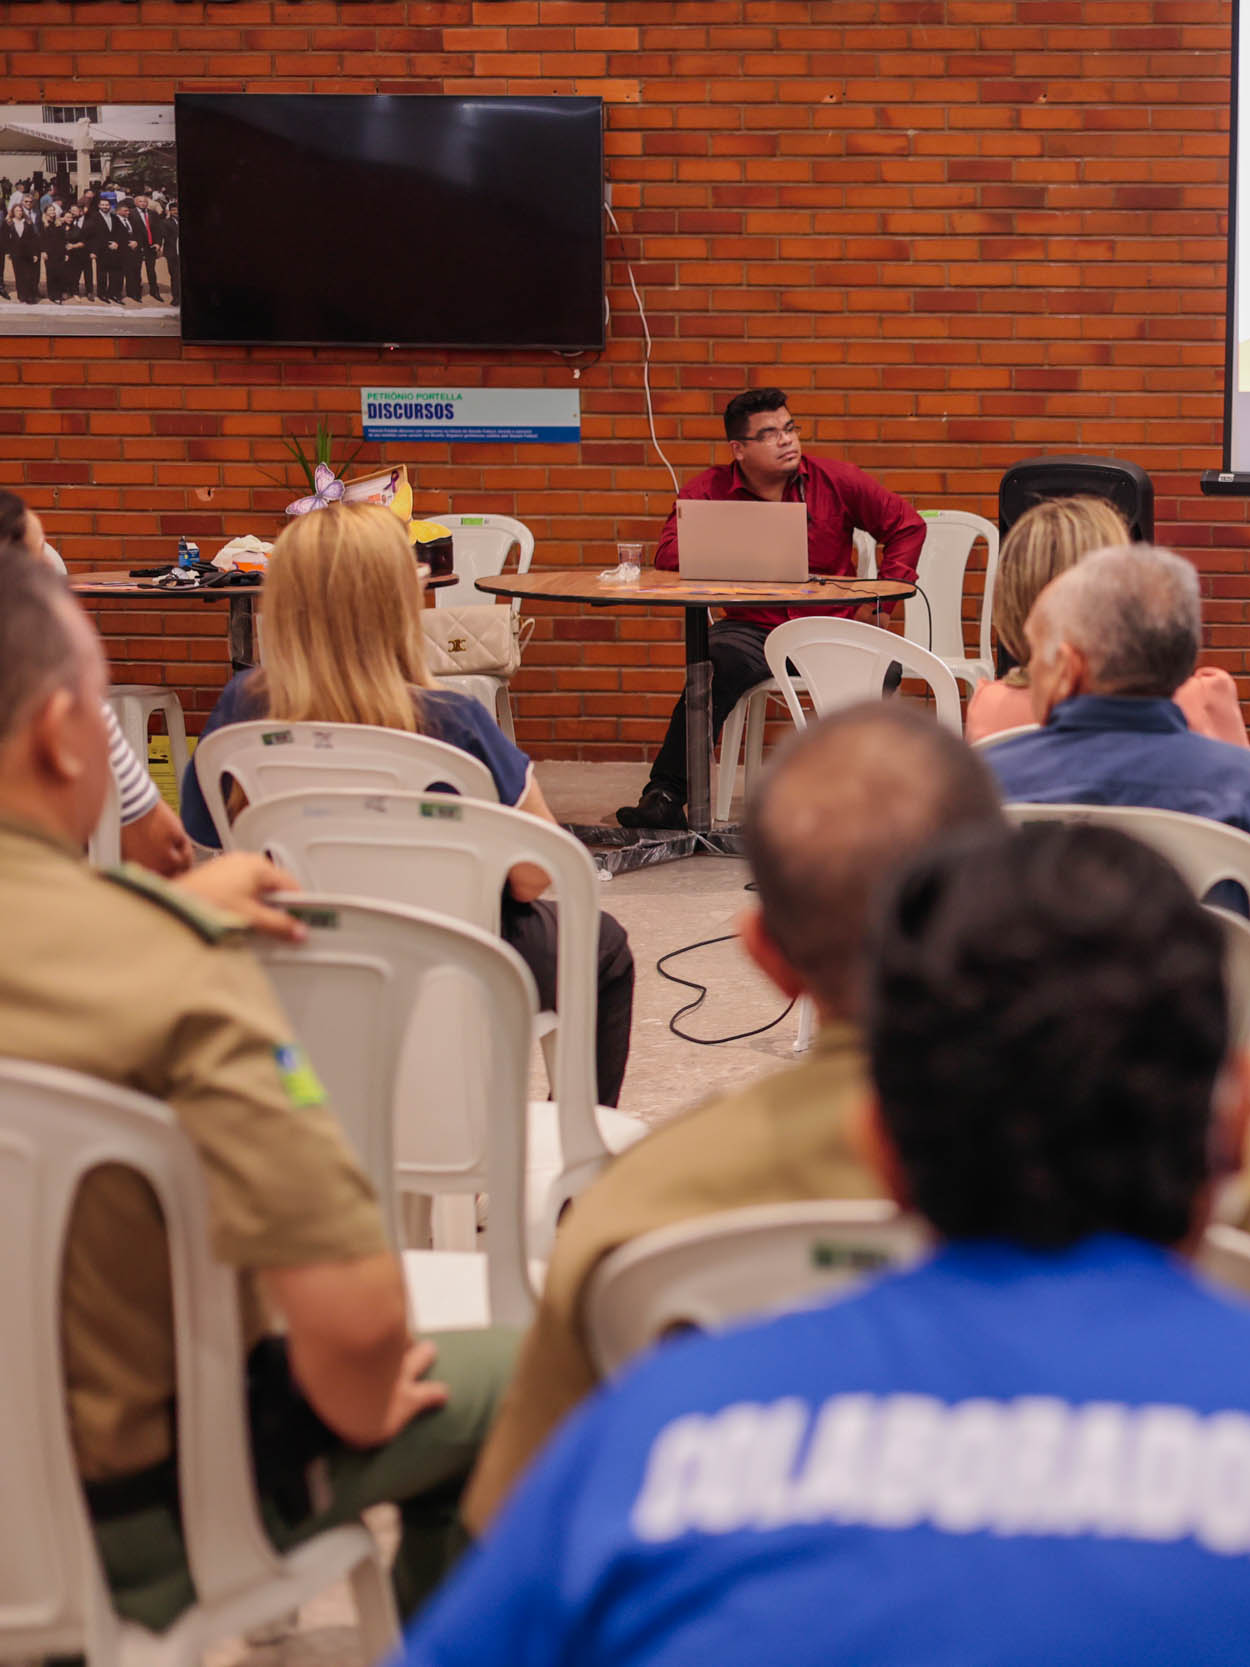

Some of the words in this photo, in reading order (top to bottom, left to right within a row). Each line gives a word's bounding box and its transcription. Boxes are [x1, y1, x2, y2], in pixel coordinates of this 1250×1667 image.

[367, 391, 414, 401] PETRÔNIO
[416, 392, 463, 401] PORTELLA
[367, 402, 454, 420] DISCURSOS
